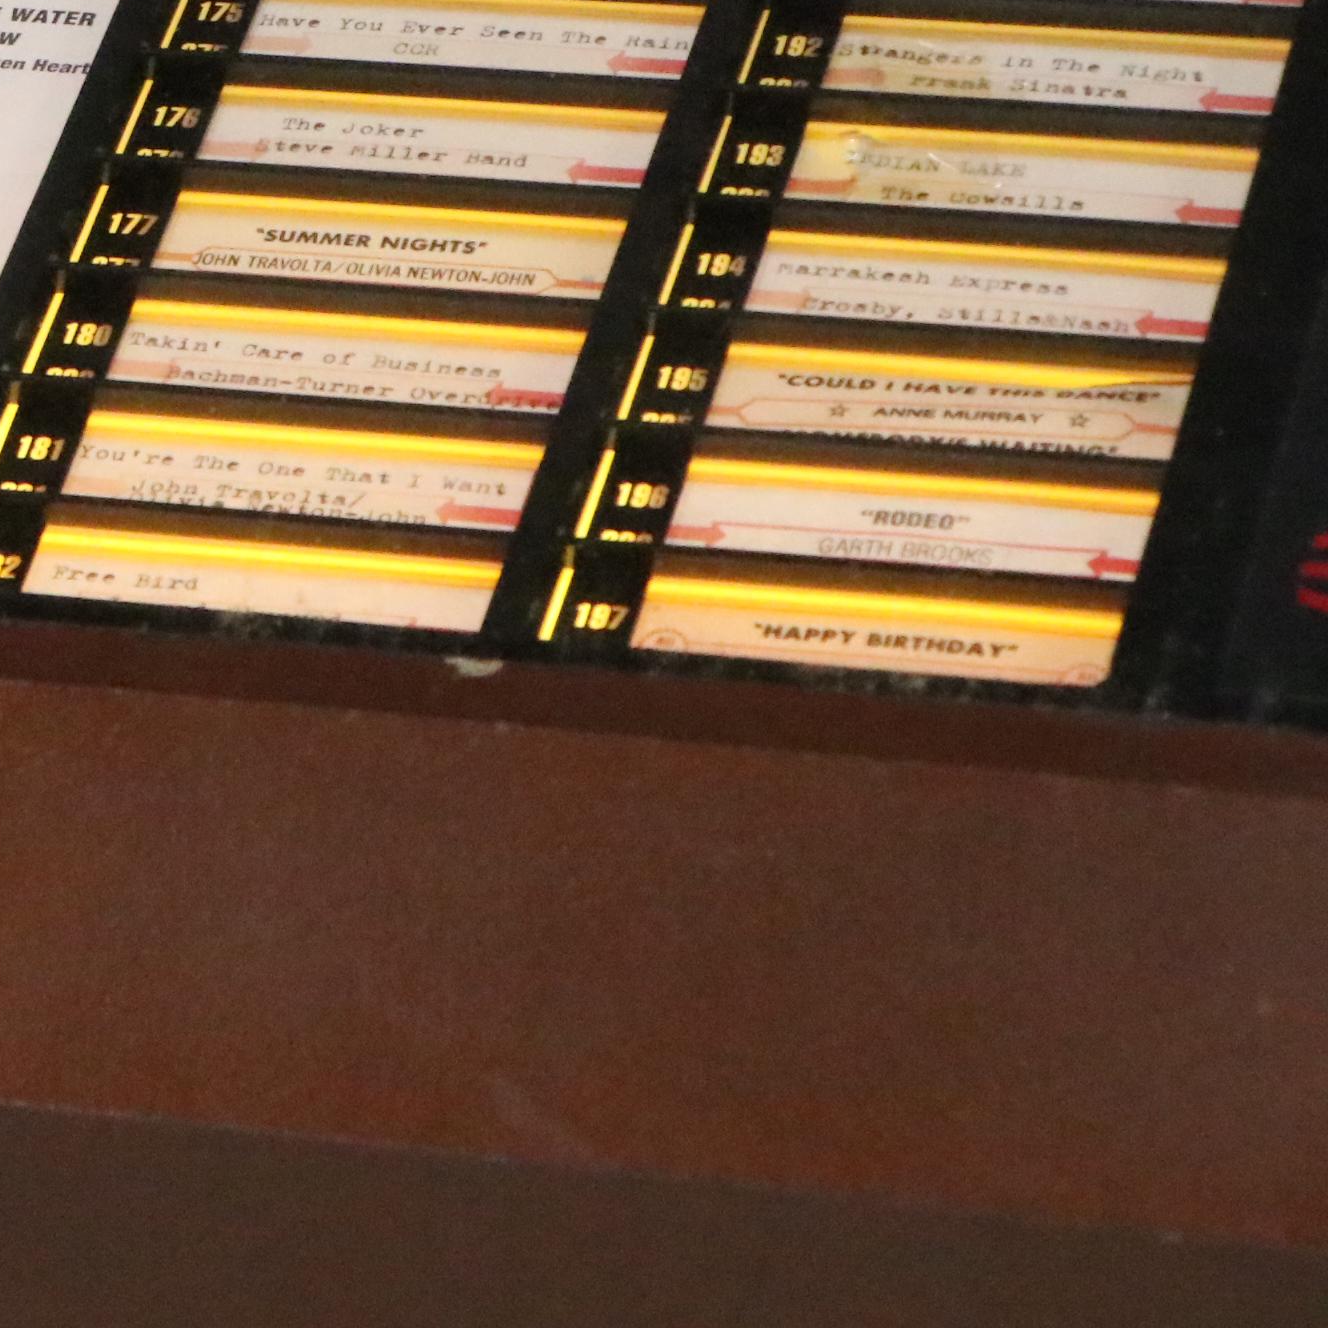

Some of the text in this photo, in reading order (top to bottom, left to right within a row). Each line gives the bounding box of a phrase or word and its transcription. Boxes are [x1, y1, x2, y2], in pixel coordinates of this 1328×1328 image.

[11, 6, 97, 27] WATER
[282, 117, 425, 139] The Joker
[257, 227, 489, 254] "SUMMER NIGHTS"
[52, 566, 199, 591] Free Bird
[756, 622, 1019, 658] "HAPPY BIRTHDAY"
